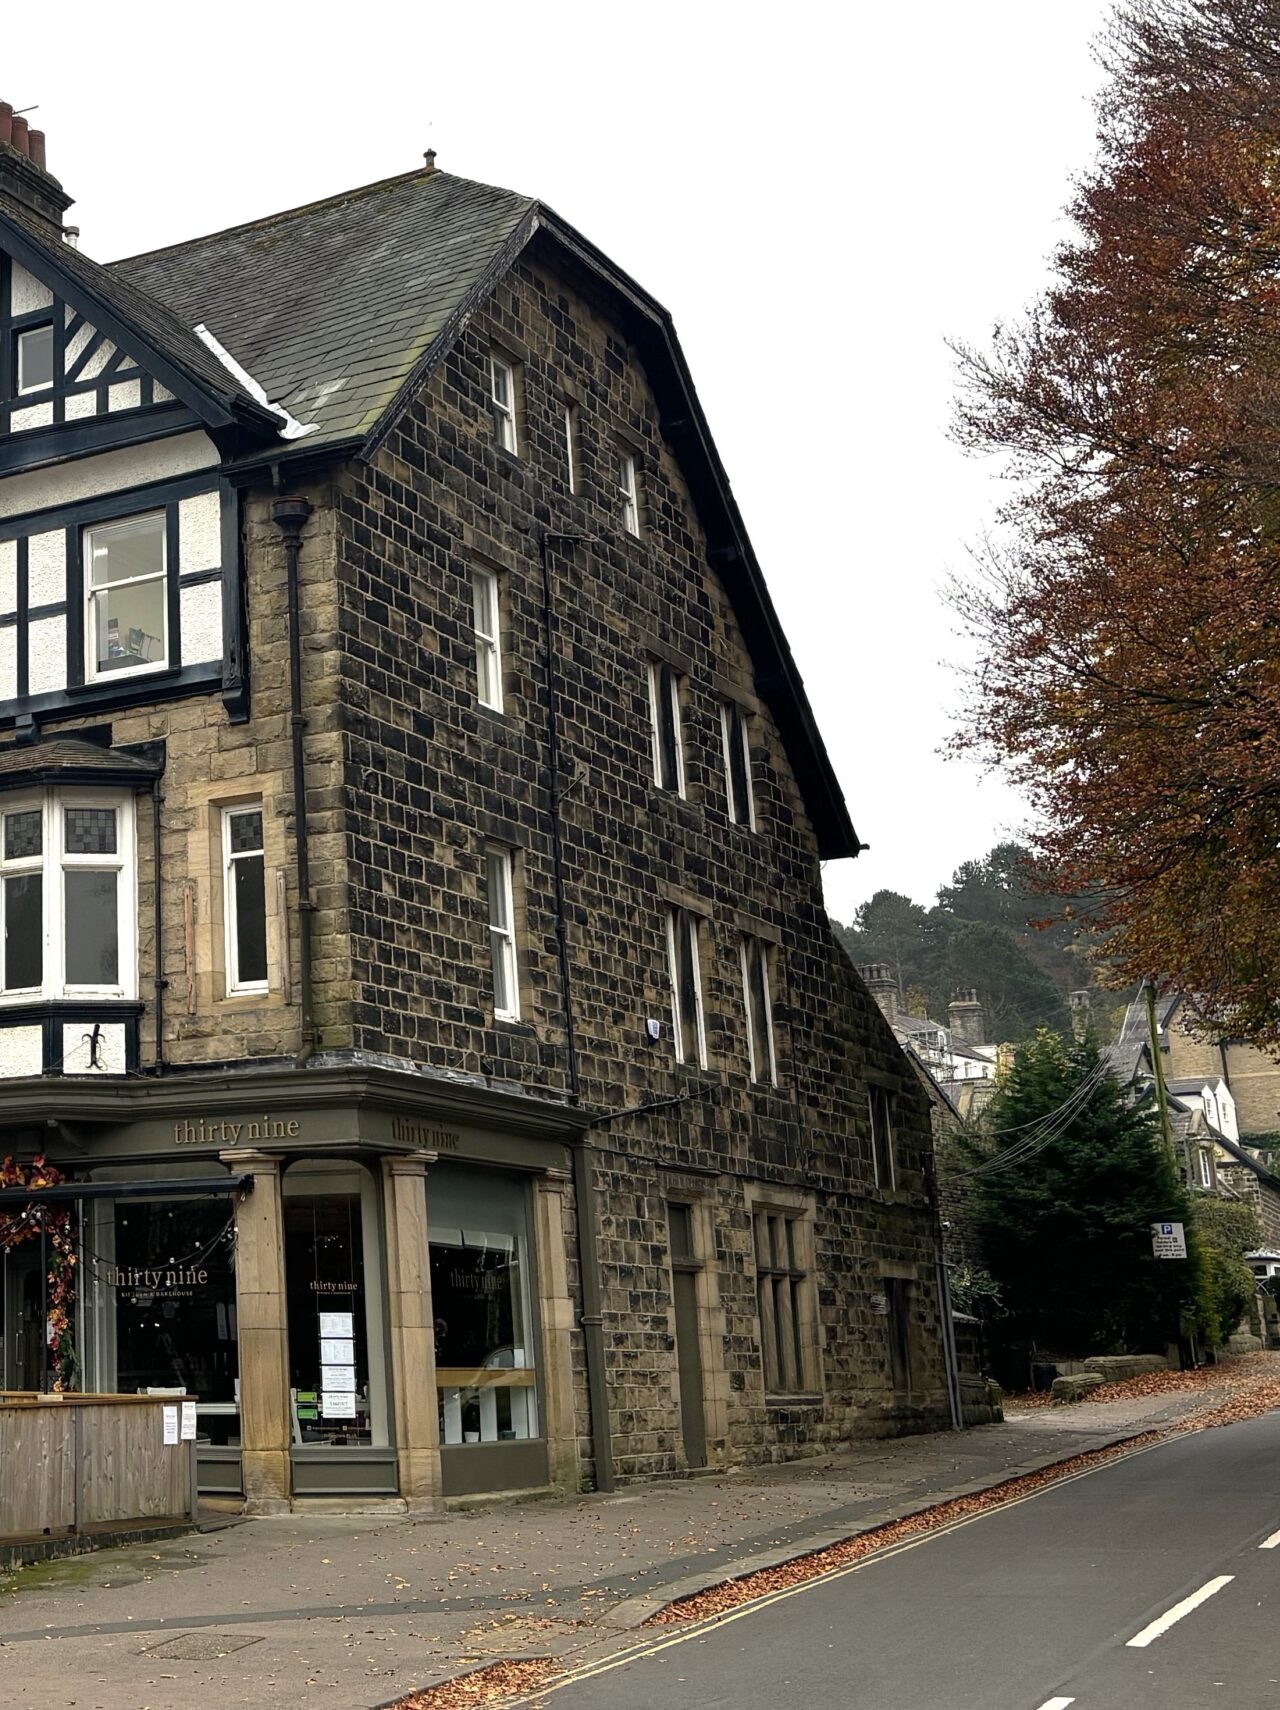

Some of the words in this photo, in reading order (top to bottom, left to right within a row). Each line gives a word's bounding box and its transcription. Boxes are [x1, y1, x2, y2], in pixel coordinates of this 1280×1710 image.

[173, 1119, 243, 1145] thirty
[247, 1115, 300, 1140] nine
[392, 1116, 430, 1149] thirty
[432, 1124, 460, 1150] nine
[107, 1267, 162, 1289] thirty
[166, 1265, 208, 1286] nine
[310, 1280, 337, 1291] thirty
[338, 1281, 358, 1291] nine
